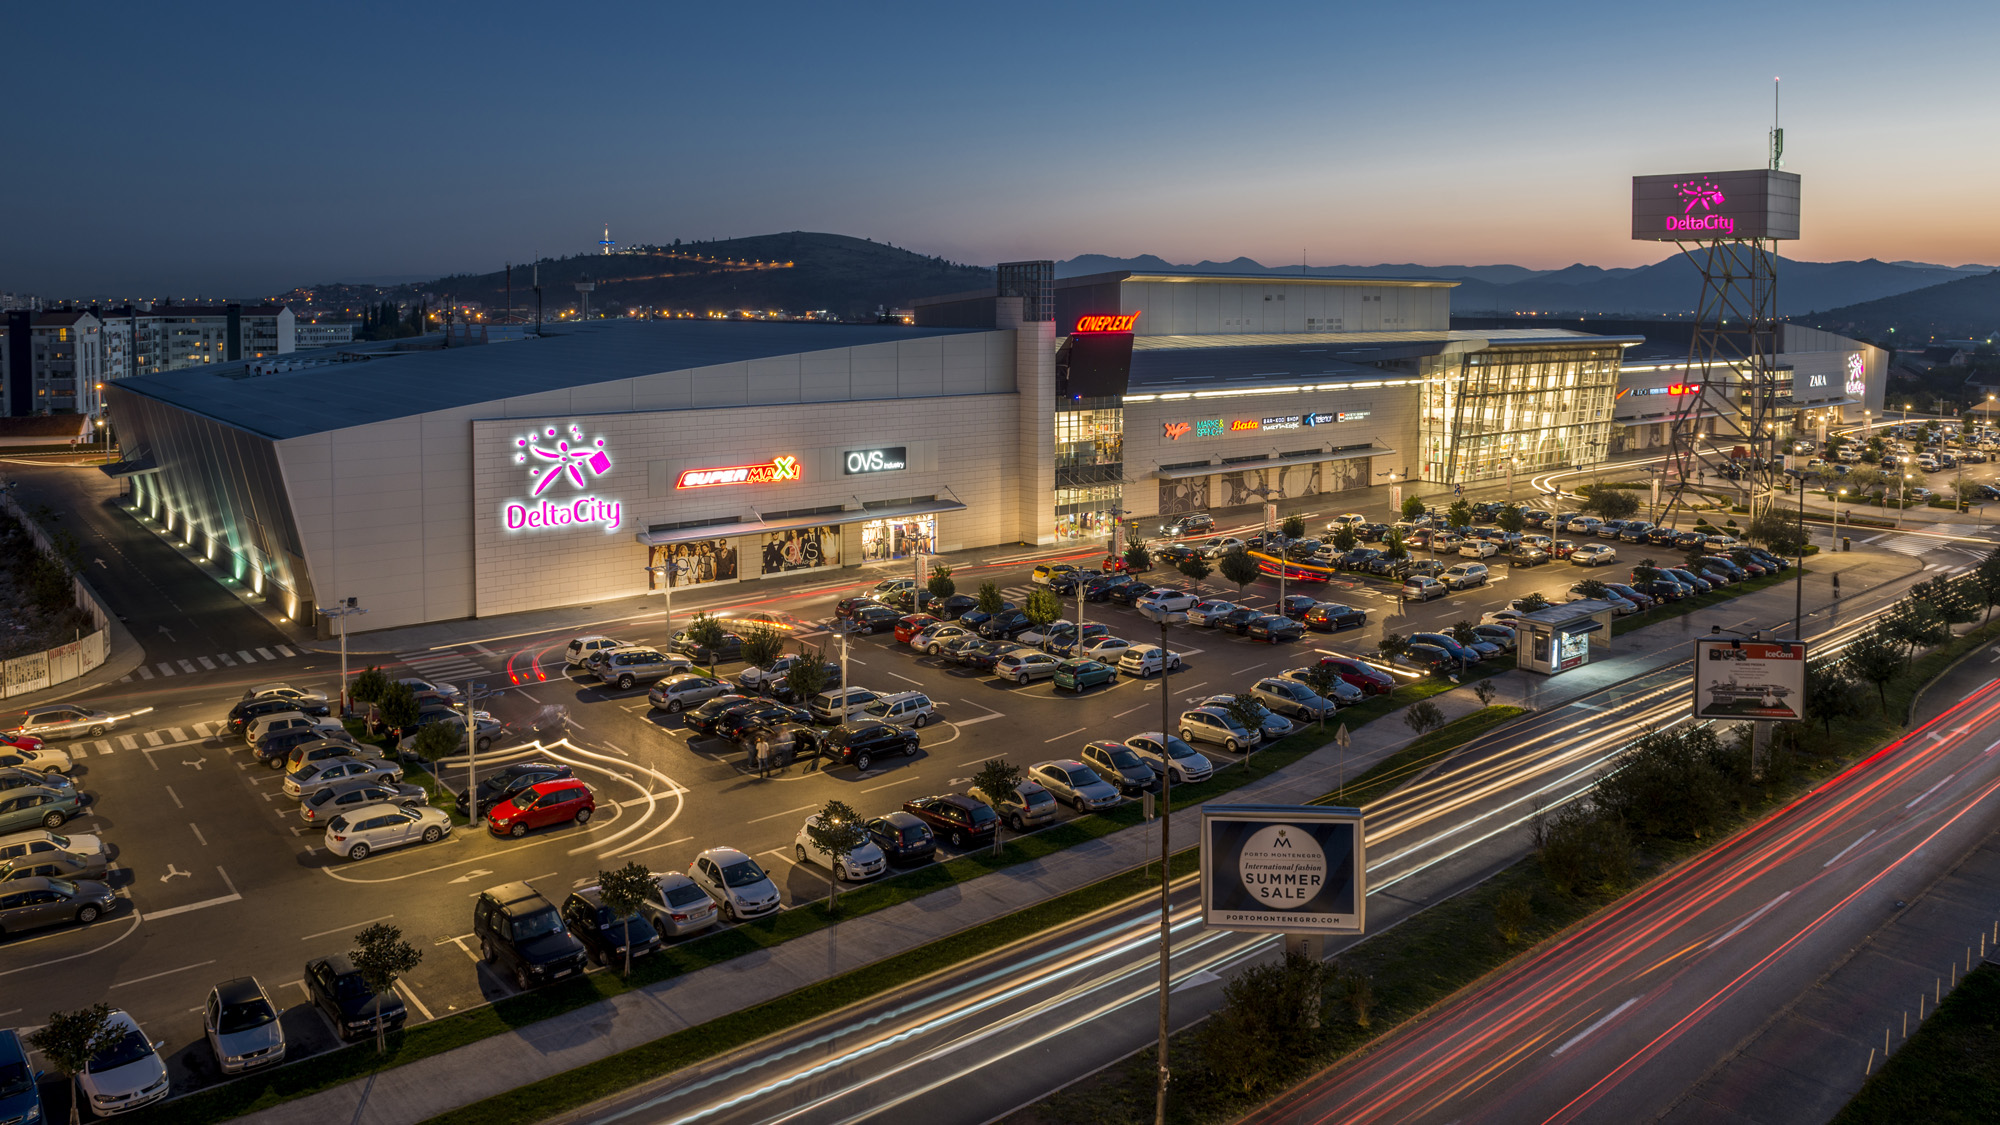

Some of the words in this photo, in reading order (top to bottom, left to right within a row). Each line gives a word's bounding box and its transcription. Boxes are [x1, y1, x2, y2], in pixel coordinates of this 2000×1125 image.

[1666, 214, 1734, 234] DeltaCity
[1076, 310, 1141, 331] CINEPLEXX
[1809, 375, 1827, 387] ZARA
[1230, 419, 1259, 431] Bata
[1196, 427, 1224, 437] SPENCER
[848, 451, 884, 472] OVS
[506, 497, 622, 530] DeltaCity
[784, 541, 818, 562] OVS
[1244, 862, 1294, 871] International
[1294, 864, 1322, 872] fashion
[1245, 873, 1321, 886] SUMMER
[1261, 887, 1306, 899] SALE
[1226, 914, 1340, 924] PORTOMONTENEGRO.COM
